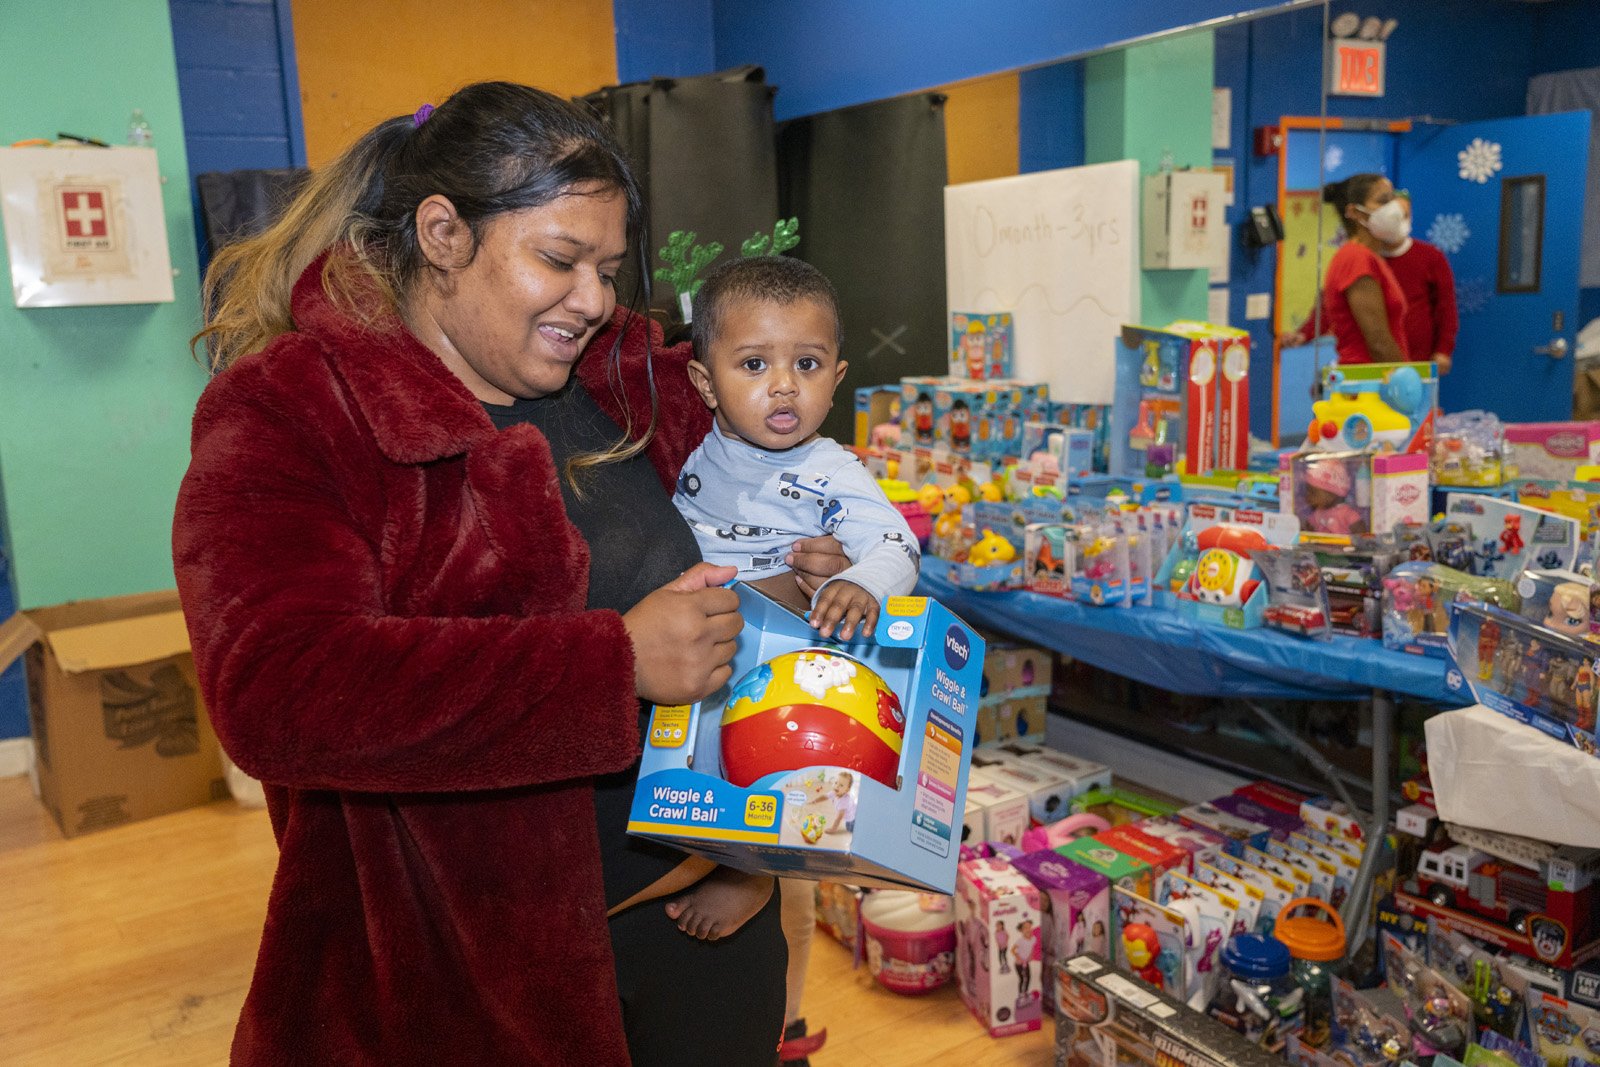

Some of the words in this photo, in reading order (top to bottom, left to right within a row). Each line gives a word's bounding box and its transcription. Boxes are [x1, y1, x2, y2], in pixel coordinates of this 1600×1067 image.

[946, 635, 969, 661] vtech
[936, 668, 960, 695] Wiggle
[960, 686, 966, 699] &
[931, 684, 952, 706] Crawl
[653, 786, 701, 805] Wiggle
[703, 789, 714, 804] &
[649, 803, 688, 820] Crawl
[749, 800, 774, 813] 6-36
[747, 813, 773, 821] Months
